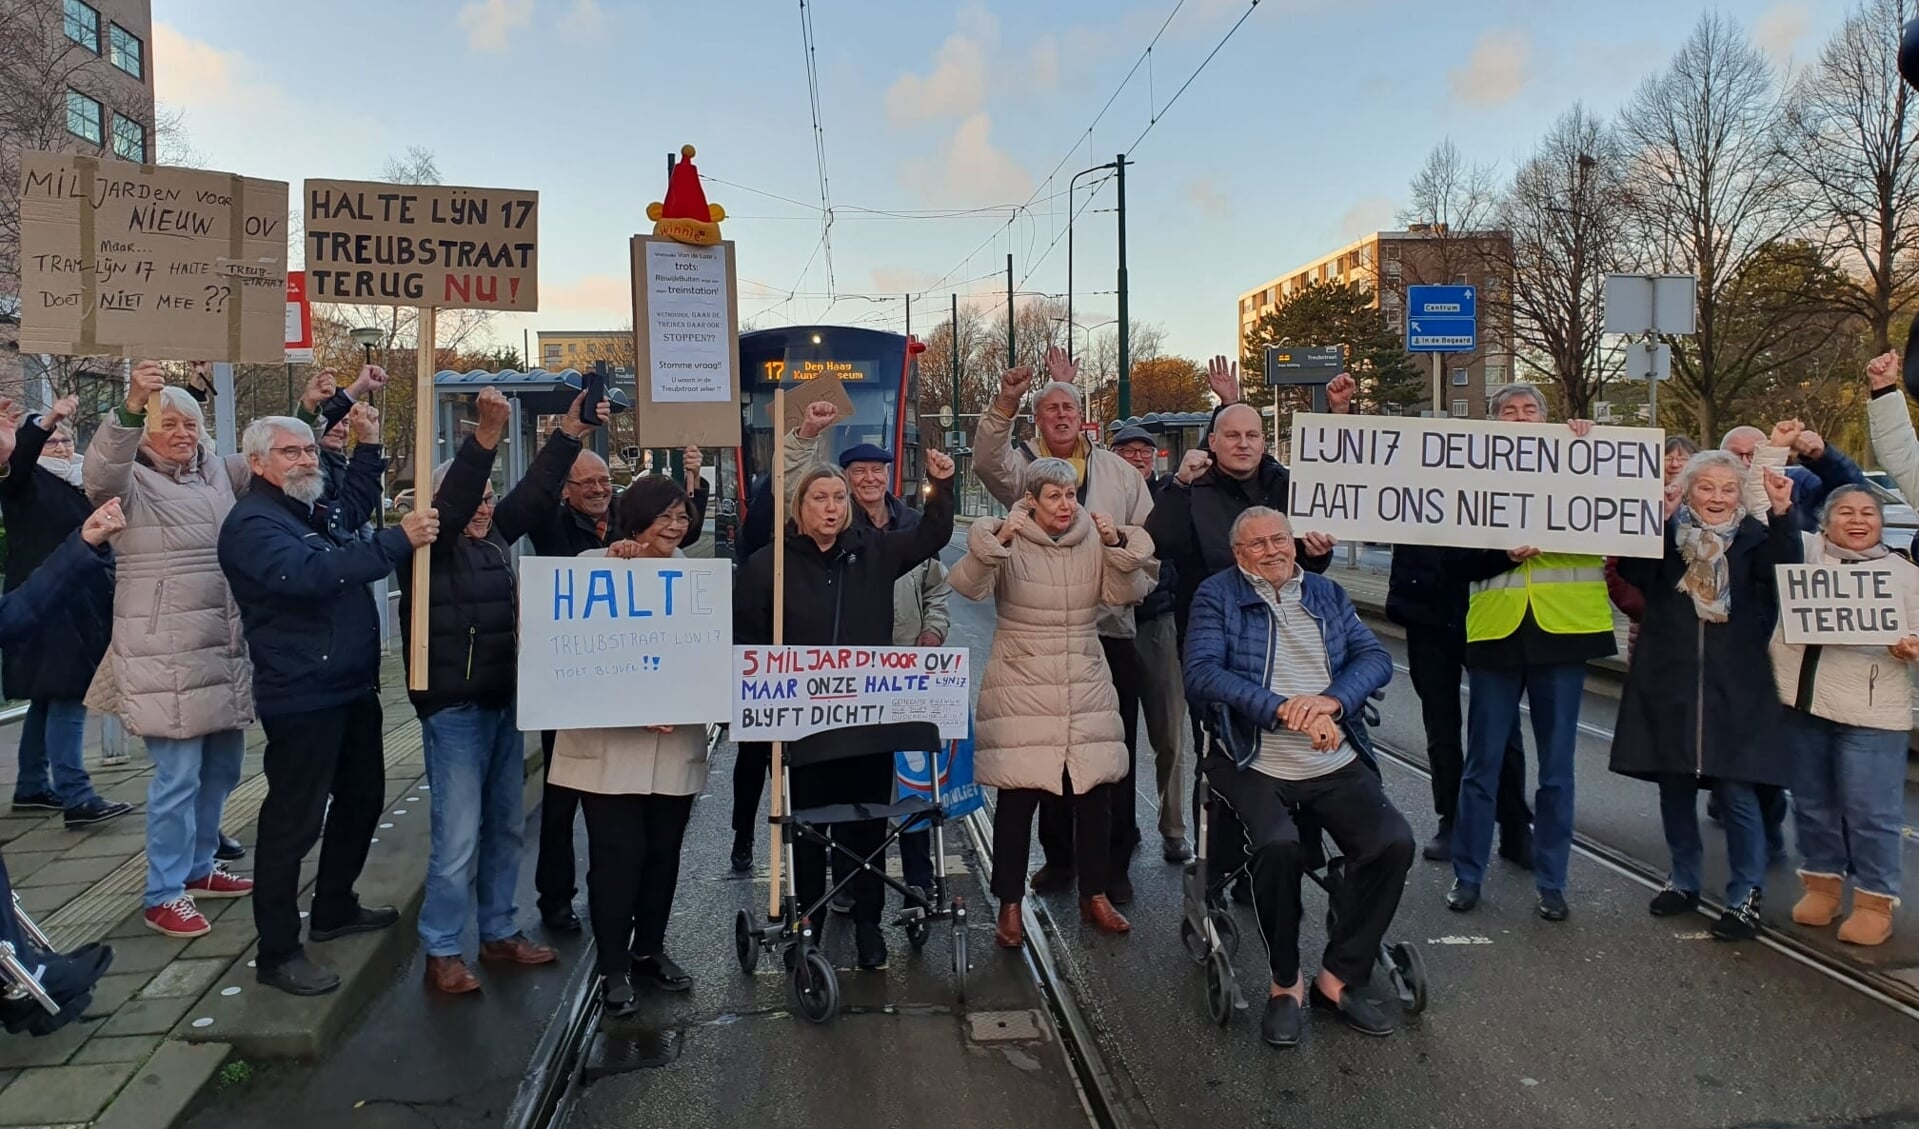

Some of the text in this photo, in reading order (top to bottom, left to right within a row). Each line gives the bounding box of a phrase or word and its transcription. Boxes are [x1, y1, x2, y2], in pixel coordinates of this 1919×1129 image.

[196, 190, 232, 206] VOOR
[311, 190, 418, 224] HALTE
[501, 200, 536, 229] 17
[245, 216, 278, 237] OV
[308, 231, 535, 268] TREUBSTRAAT
[136, 261, 157, 283] 17
[169, 261, 210, 275] HALTE
[675, 262, 699, 271] trots:
[312, 270, 424, 299] TERUG
[156, 294, 194, 309] MEE
[659, 360, 693, 370] Stomme
[764, 361, 852, 380] 17 Den Haag
[1421, 432, 1559, 473] DEUREN
[1568, 439, 1660, 479] OPEN
[1290, 481, 1663, 537] LAAT ONS NIET LOPEN
[554, 568, 713, 620] HALTE
[1787, 569, 1892, 599] HALTE
[1792, 607, 1898, 632] TERUG
[551, 631, 666, 656] TREUBSTRAAT
[555, 667, 586, 680] MOET
[742, 650, 759, 676] 5
[880, 651, 917, 669] VOOR
[924, 653, 962, 674] OV!
[742, 678, 798, 700] MAAR
[807, 676, 857, 696] ONZE
[865, 675, 930, 693] HALTE
